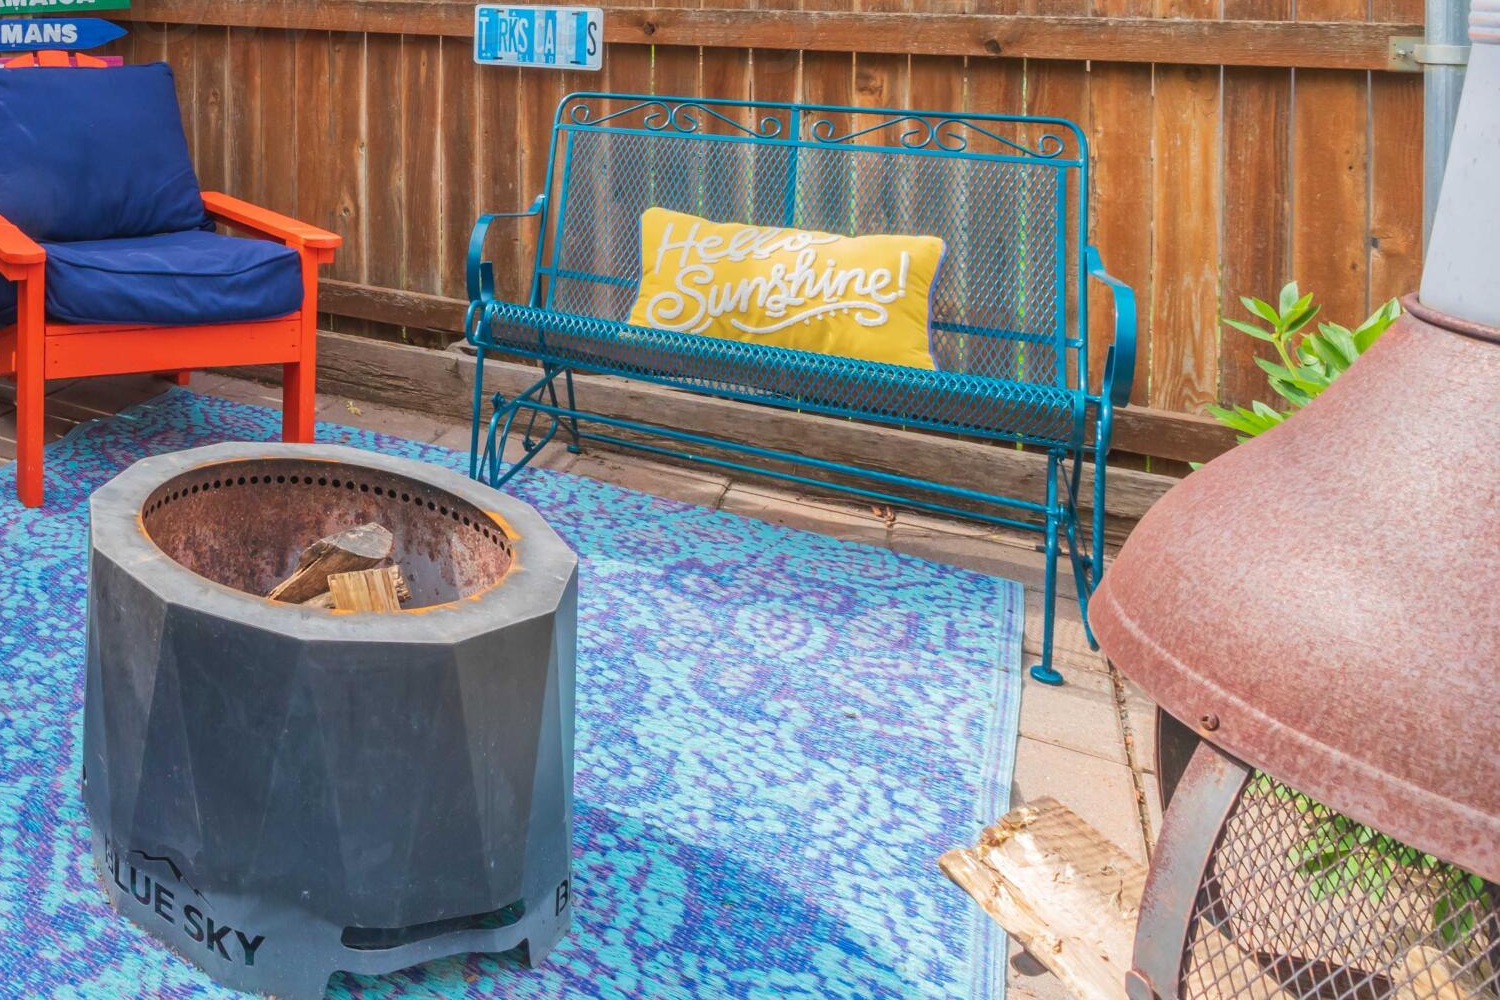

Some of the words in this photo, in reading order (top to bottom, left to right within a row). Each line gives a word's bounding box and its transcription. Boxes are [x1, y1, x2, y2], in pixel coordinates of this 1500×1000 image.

[653, 222, 842, 276] Hello
[646, 250, 910, 335] Sunshine!
[104, 832, 176, 925] BLUE
[183, 904, 267, 967] SKY
